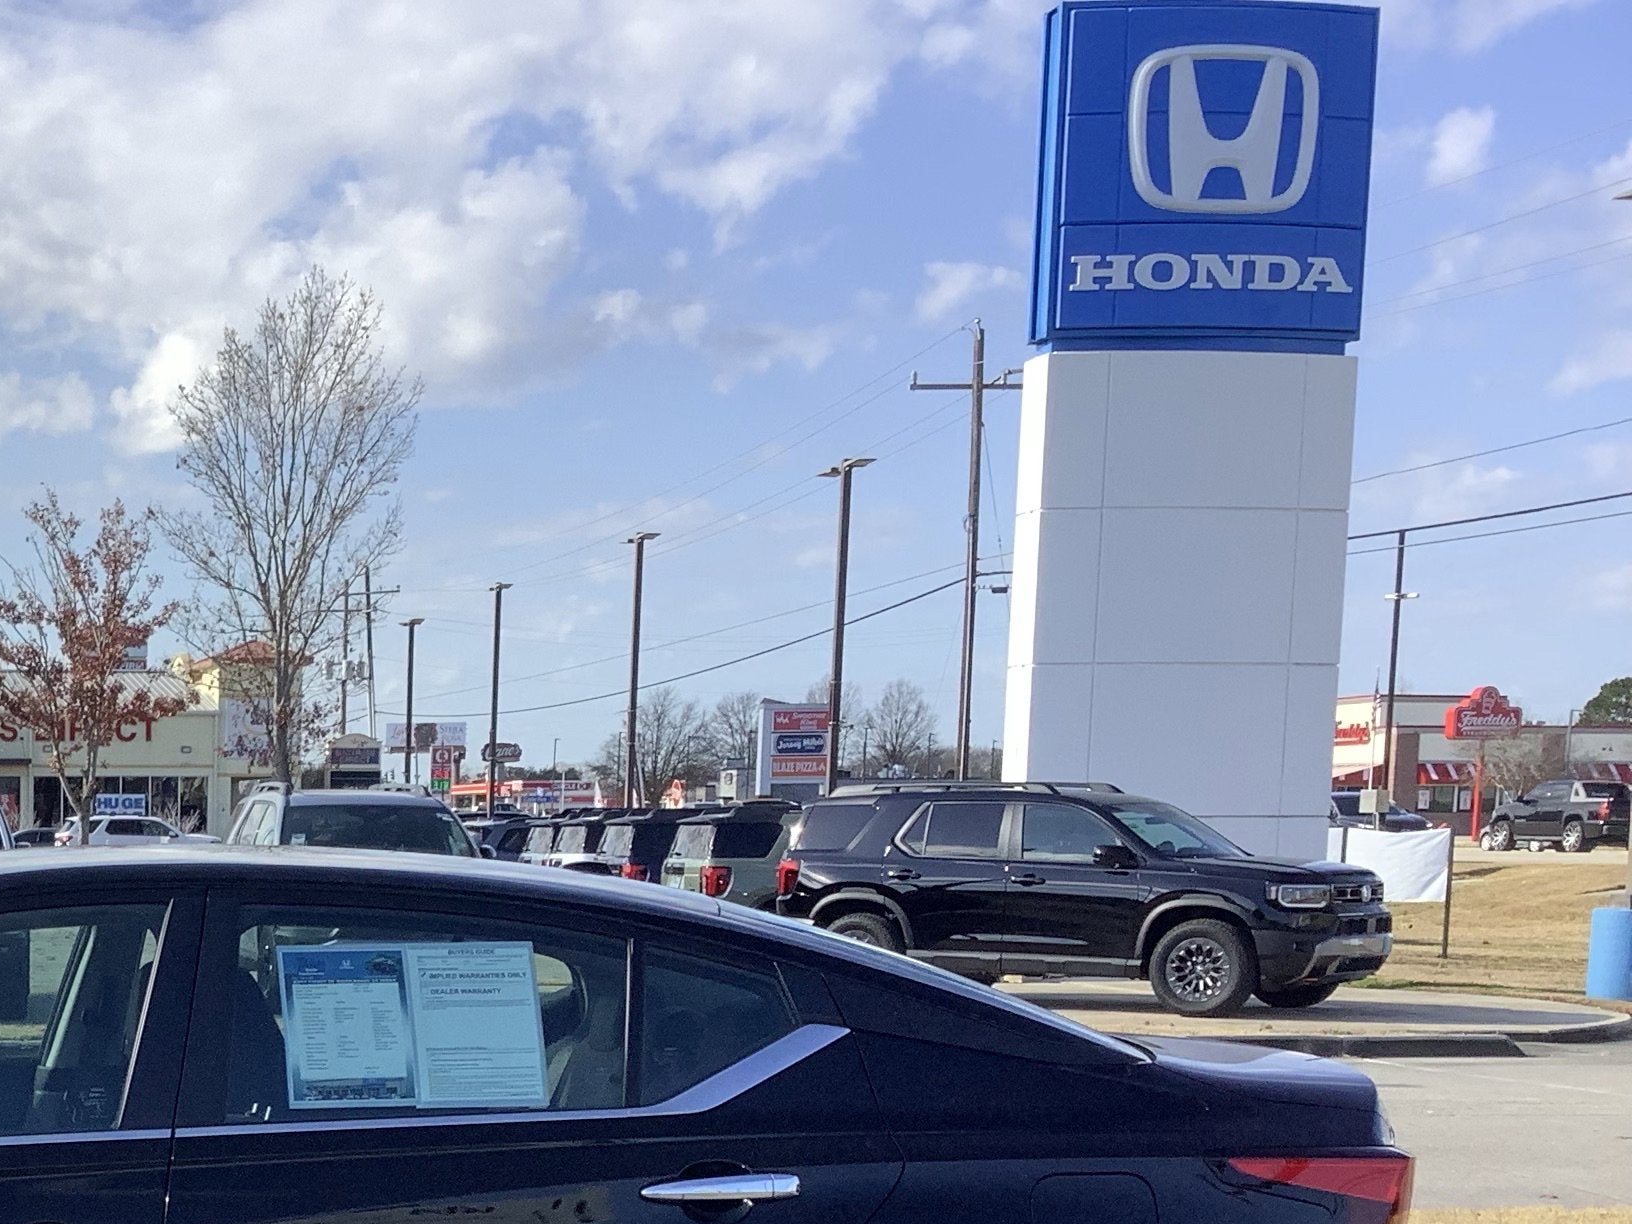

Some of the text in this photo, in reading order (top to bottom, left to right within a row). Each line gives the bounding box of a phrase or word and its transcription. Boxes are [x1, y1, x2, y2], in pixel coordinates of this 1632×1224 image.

[1069, 252, 1353, 293] HONDA
[34, 714, 159, 742] ICT
[1458, 711, 1518, 728] Freddy's
[797, 761, 818, 773] PIZZA
[96, 797, 144, 809] HUGE
